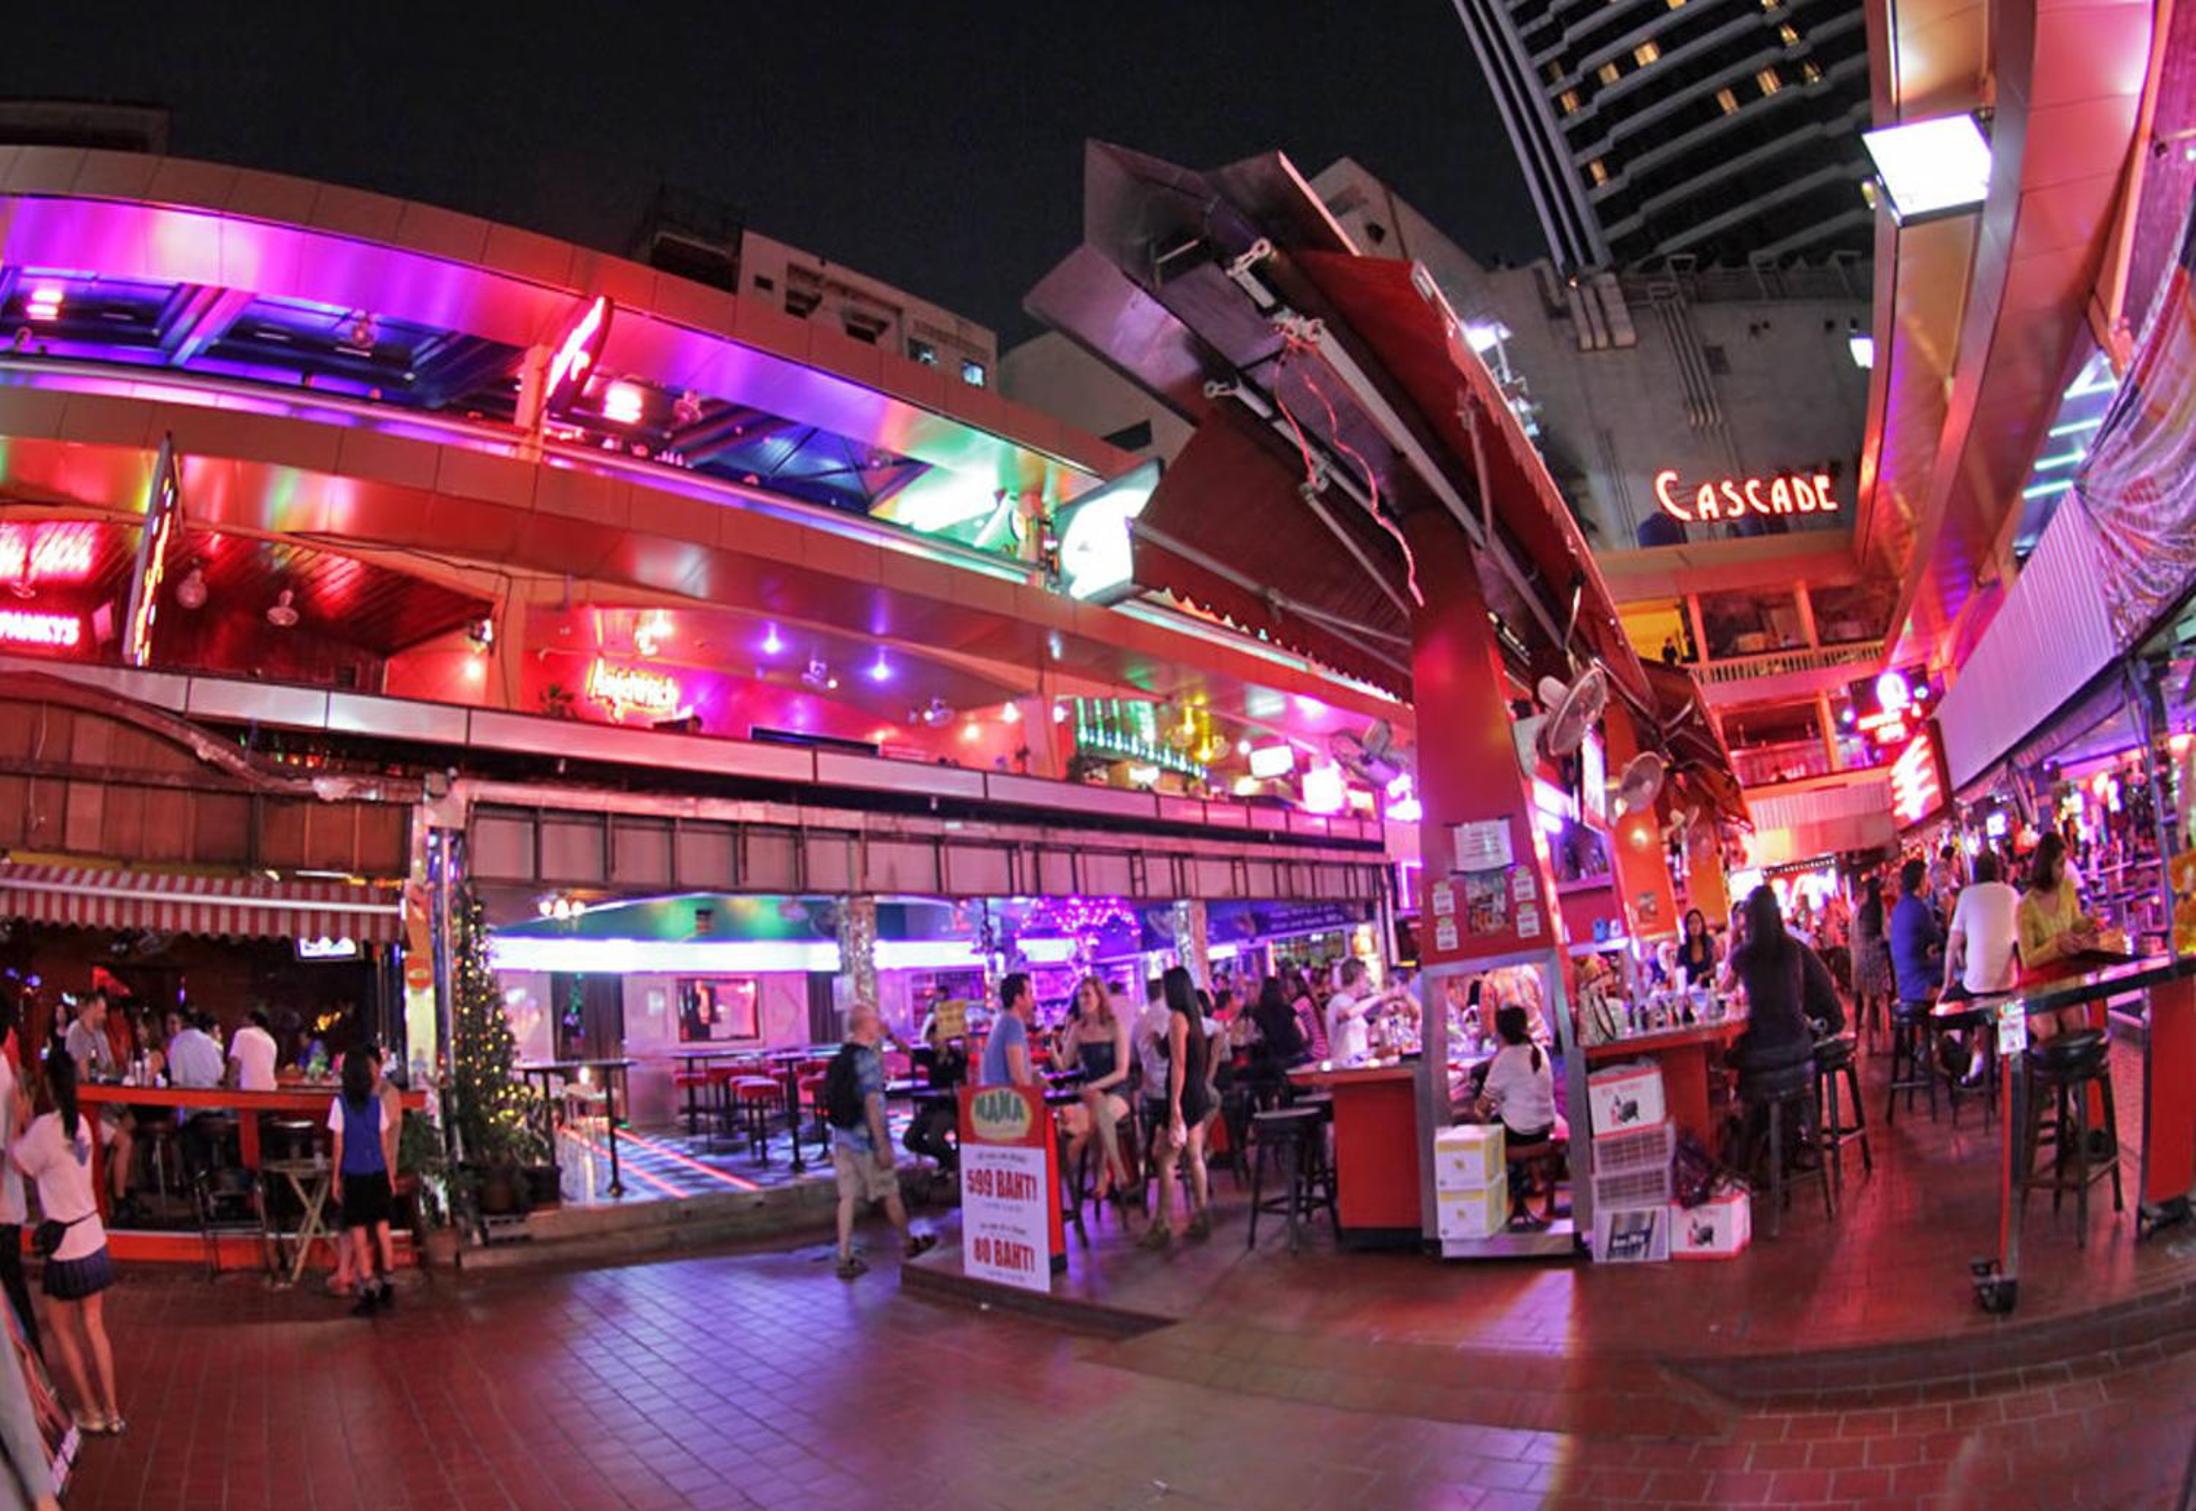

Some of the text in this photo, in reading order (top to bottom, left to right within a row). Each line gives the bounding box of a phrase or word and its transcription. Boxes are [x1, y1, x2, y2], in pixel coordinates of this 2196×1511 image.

[1655, 469, 1839, 522] CASCADE
[996, 1168, 1038, 1202] BAHT!
[994, 1238, 1036, 1275] BAHT!
